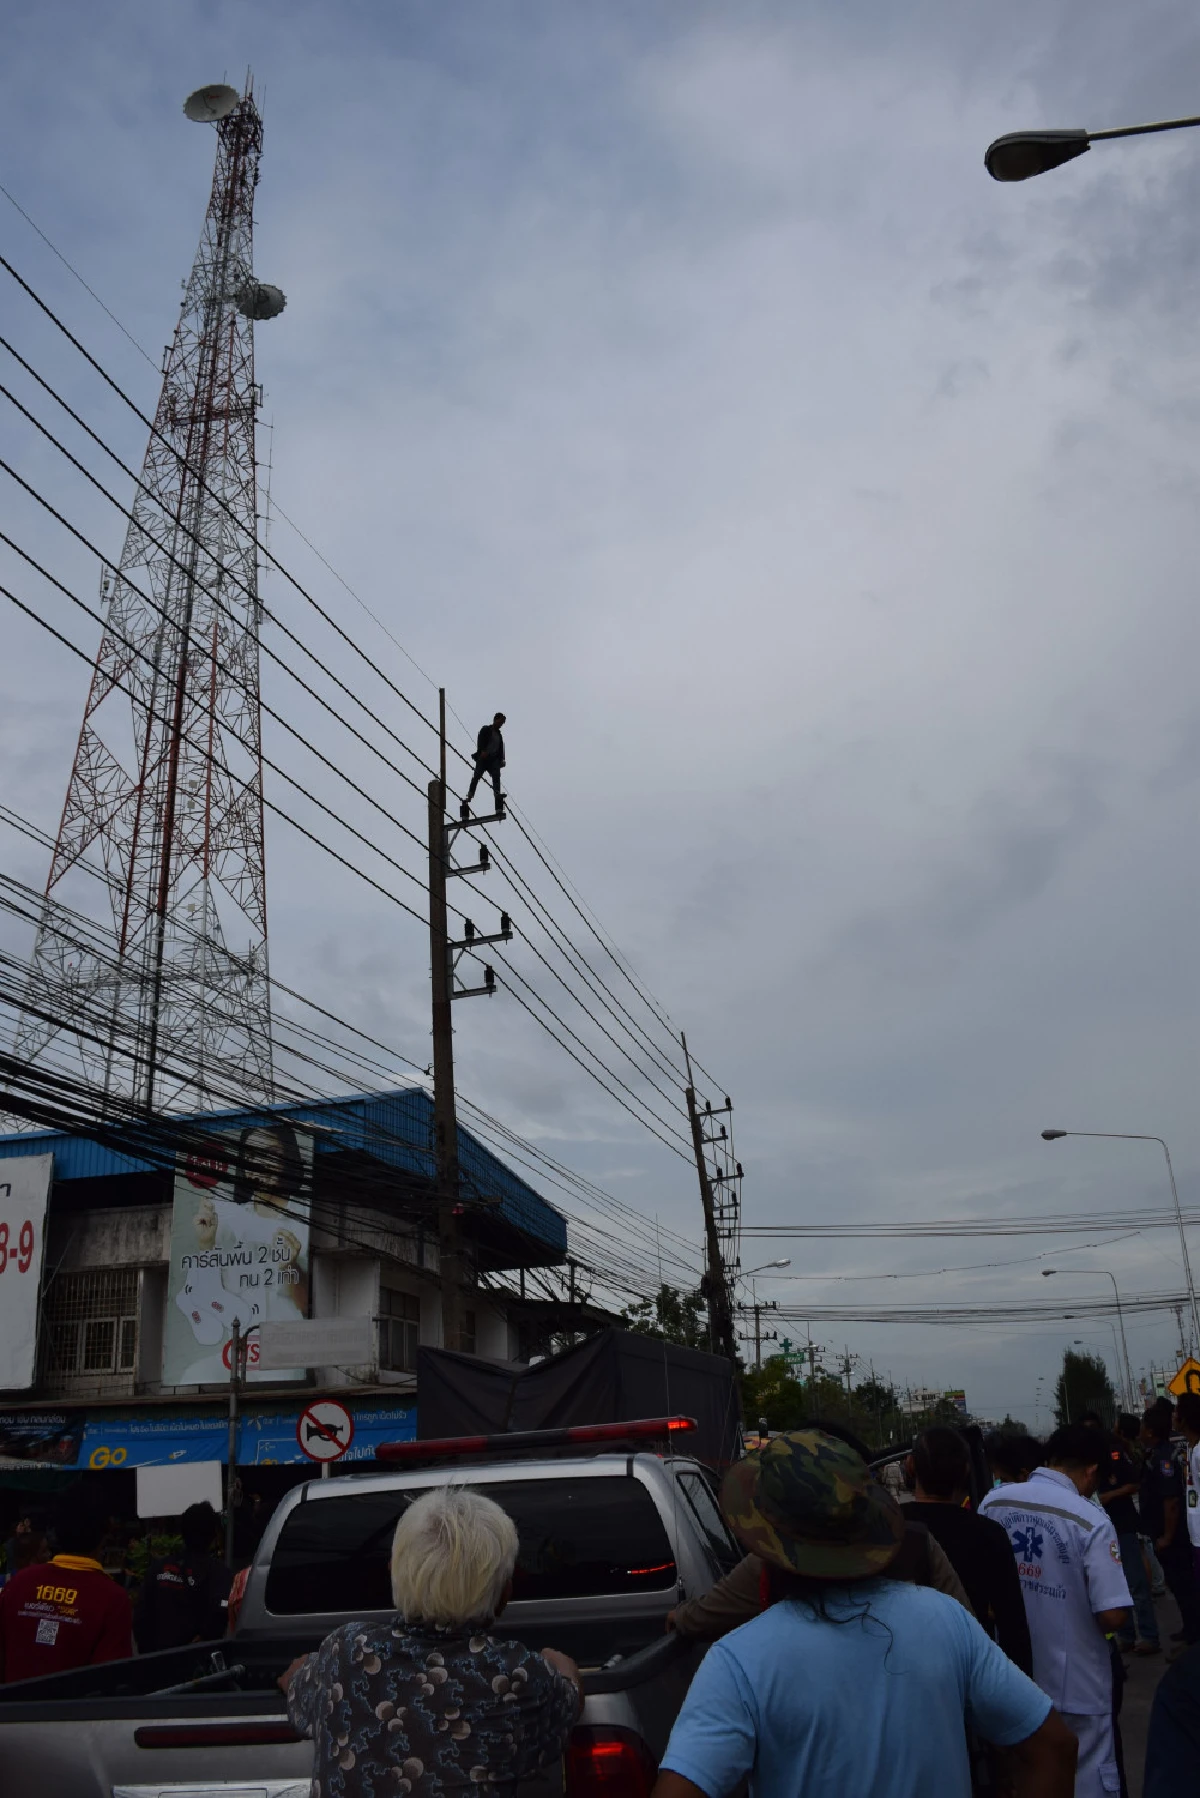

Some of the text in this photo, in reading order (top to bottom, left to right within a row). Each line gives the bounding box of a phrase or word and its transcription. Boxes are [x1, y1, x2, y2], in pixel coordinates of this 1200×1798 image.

[258, 1246, 268, 1263] 2
[271, 1237, 291, 1263] ชั้น
[264, 1268, 273, 1286] 2
[1018, 1563, 1042, 1578] 669
[35, 1584, 78, 1605] 1669
